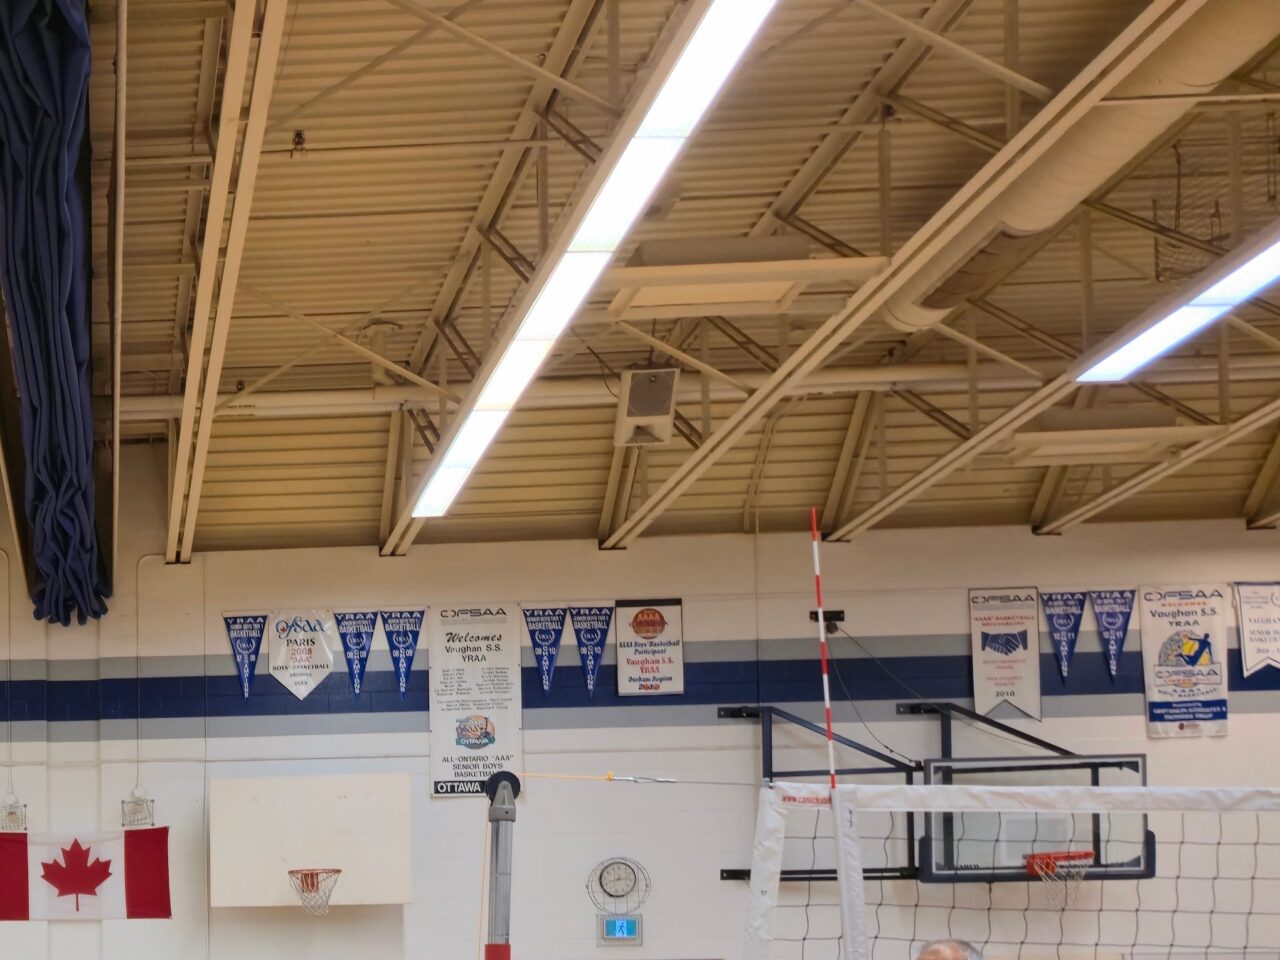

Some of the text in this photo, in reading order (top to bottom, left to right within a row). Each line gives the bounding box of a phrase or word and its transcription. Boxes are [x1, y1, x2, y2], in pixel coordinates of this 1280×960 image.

[1046, 606, 1081, 614] BASKETBALL
[1150, 609, 1198, 618] Vaughan
[339, 624, 373, 632] BASKETBALL
[385, 623, 419, 631] BASKETBALL
[528, 621, 562, 629] BASKETBALL
[574, 620, 607, 629] BASKETBALL
[231, 630, 261, 638] BASKETBALL
[445, 632, 502, 643] Welcomes
[286, 639, 315, 647] PARIS
[445, 645, 482, 654] Vaughan
[461, 654, 487, 662] YRAA
[626, 658, 660, 666] Vaughan
[640, 666, 660, 674] YRAA
[442, 755, 488, 763] ALL-ONTARIO
[437, 783, 482, 792] OTTAWA
